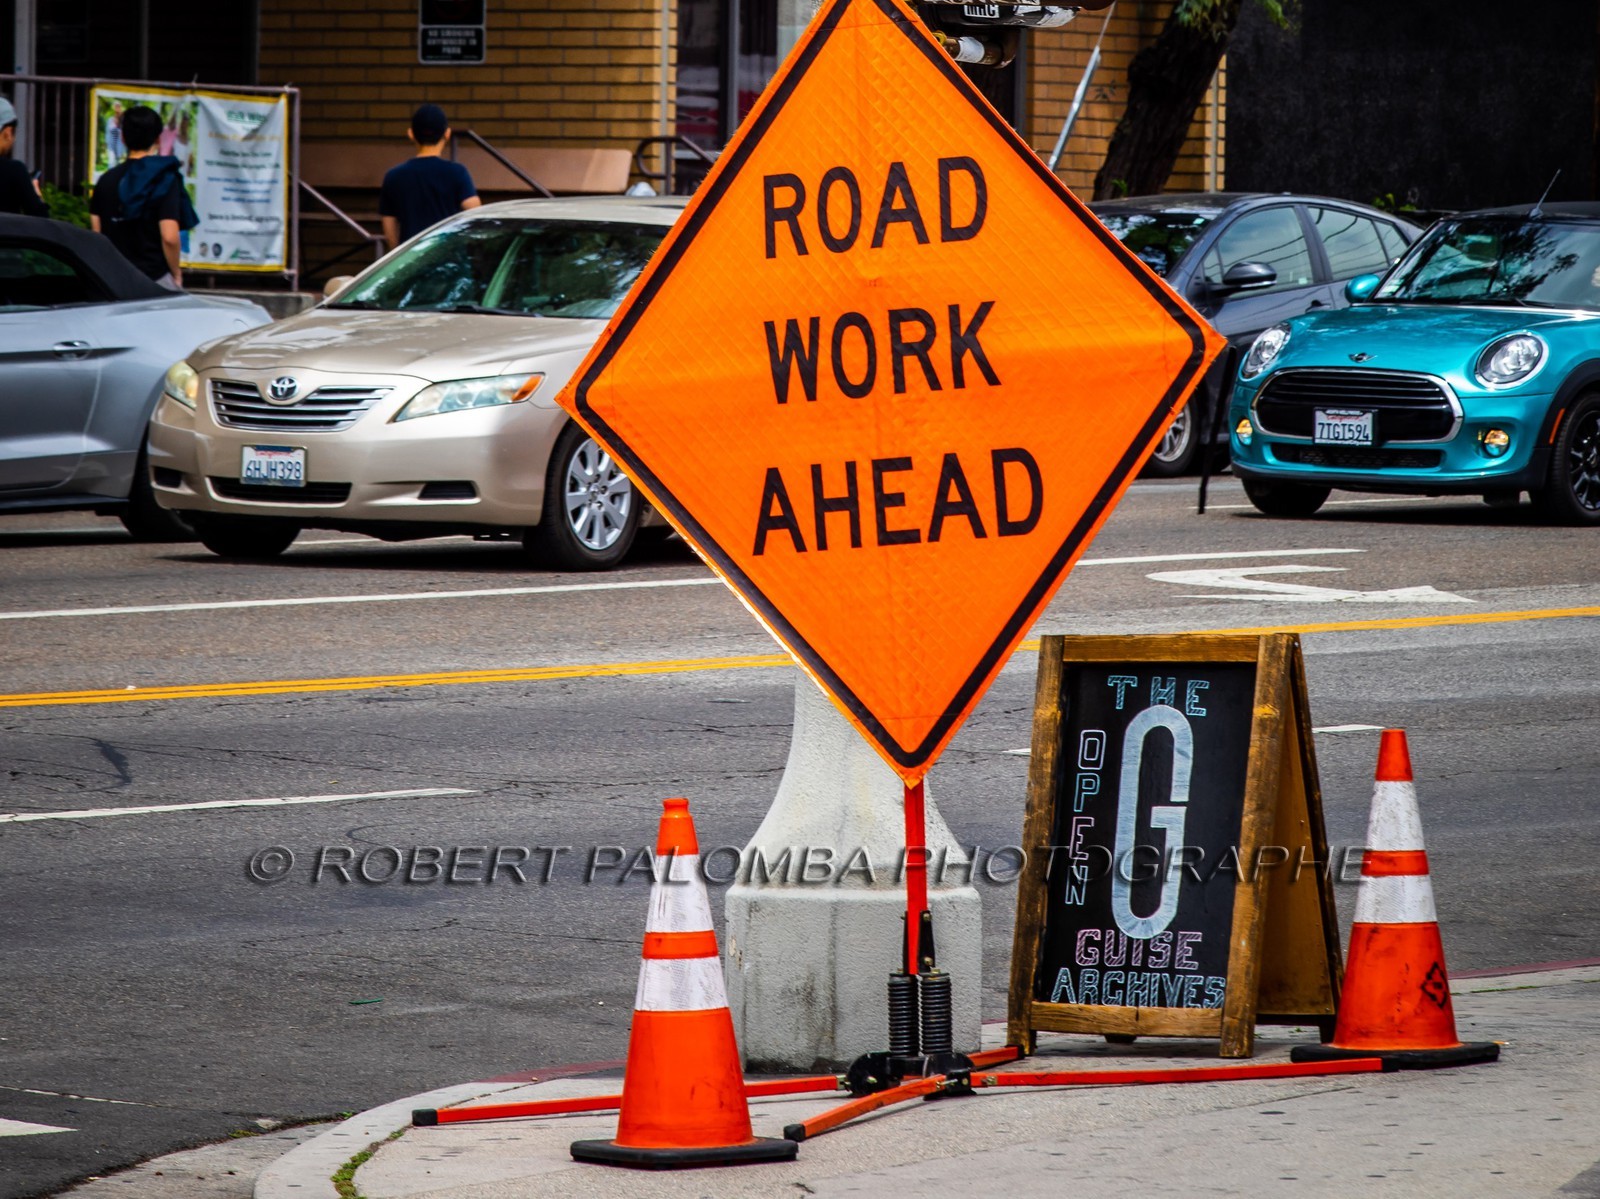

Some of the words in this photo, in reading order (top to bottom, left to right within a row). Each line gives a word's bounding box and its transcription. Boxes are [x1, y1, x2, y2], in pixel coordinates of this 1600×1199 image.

[763, 156, 989, 259] ROAD
[763, 300, 1003, 405] WORK
[1317, 422, 1371, 442] 7TGT594
[245, 460, 302, 479] 6HJH398
[752, 446, 1045, 556] AHEAD
[1107, 674, 1210, 716] THE
[1065, 729, 1106, 905] OPEN
[1111, 704, 1194, 939] G
[1075, 928, 1203, 971] GUISE
[1050, 966, 1226, 1009] ARCHIVES
